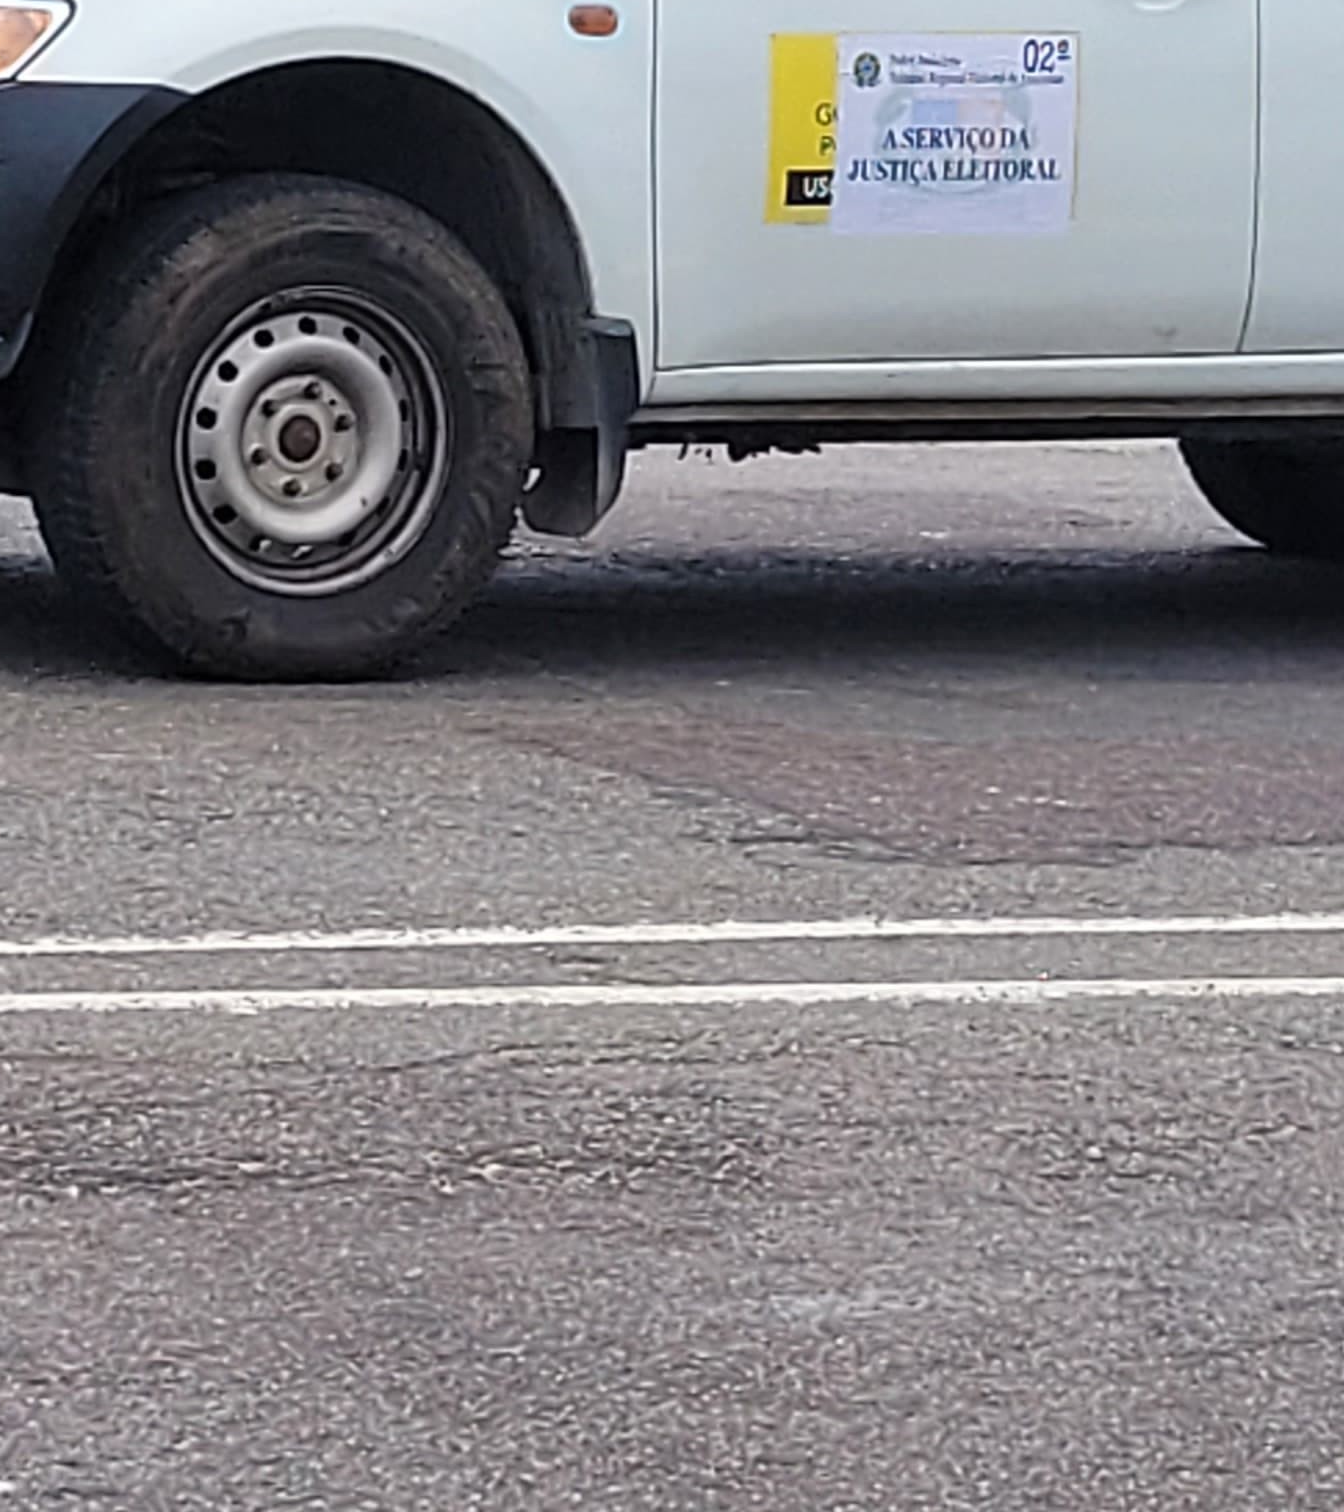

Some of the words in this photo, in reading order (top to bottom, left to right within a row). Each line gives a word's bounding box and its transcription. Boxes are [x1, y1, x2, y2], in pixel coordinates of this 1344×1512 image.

[882, 127, 897, 150] A
[900, 127, 996, 154] SERVIÇO
[1000, 127, 1030, 150] DA
[847, 158, 938, 186] JUSTIÇA
[942, 158, 1061, 181] ELEITORAL
